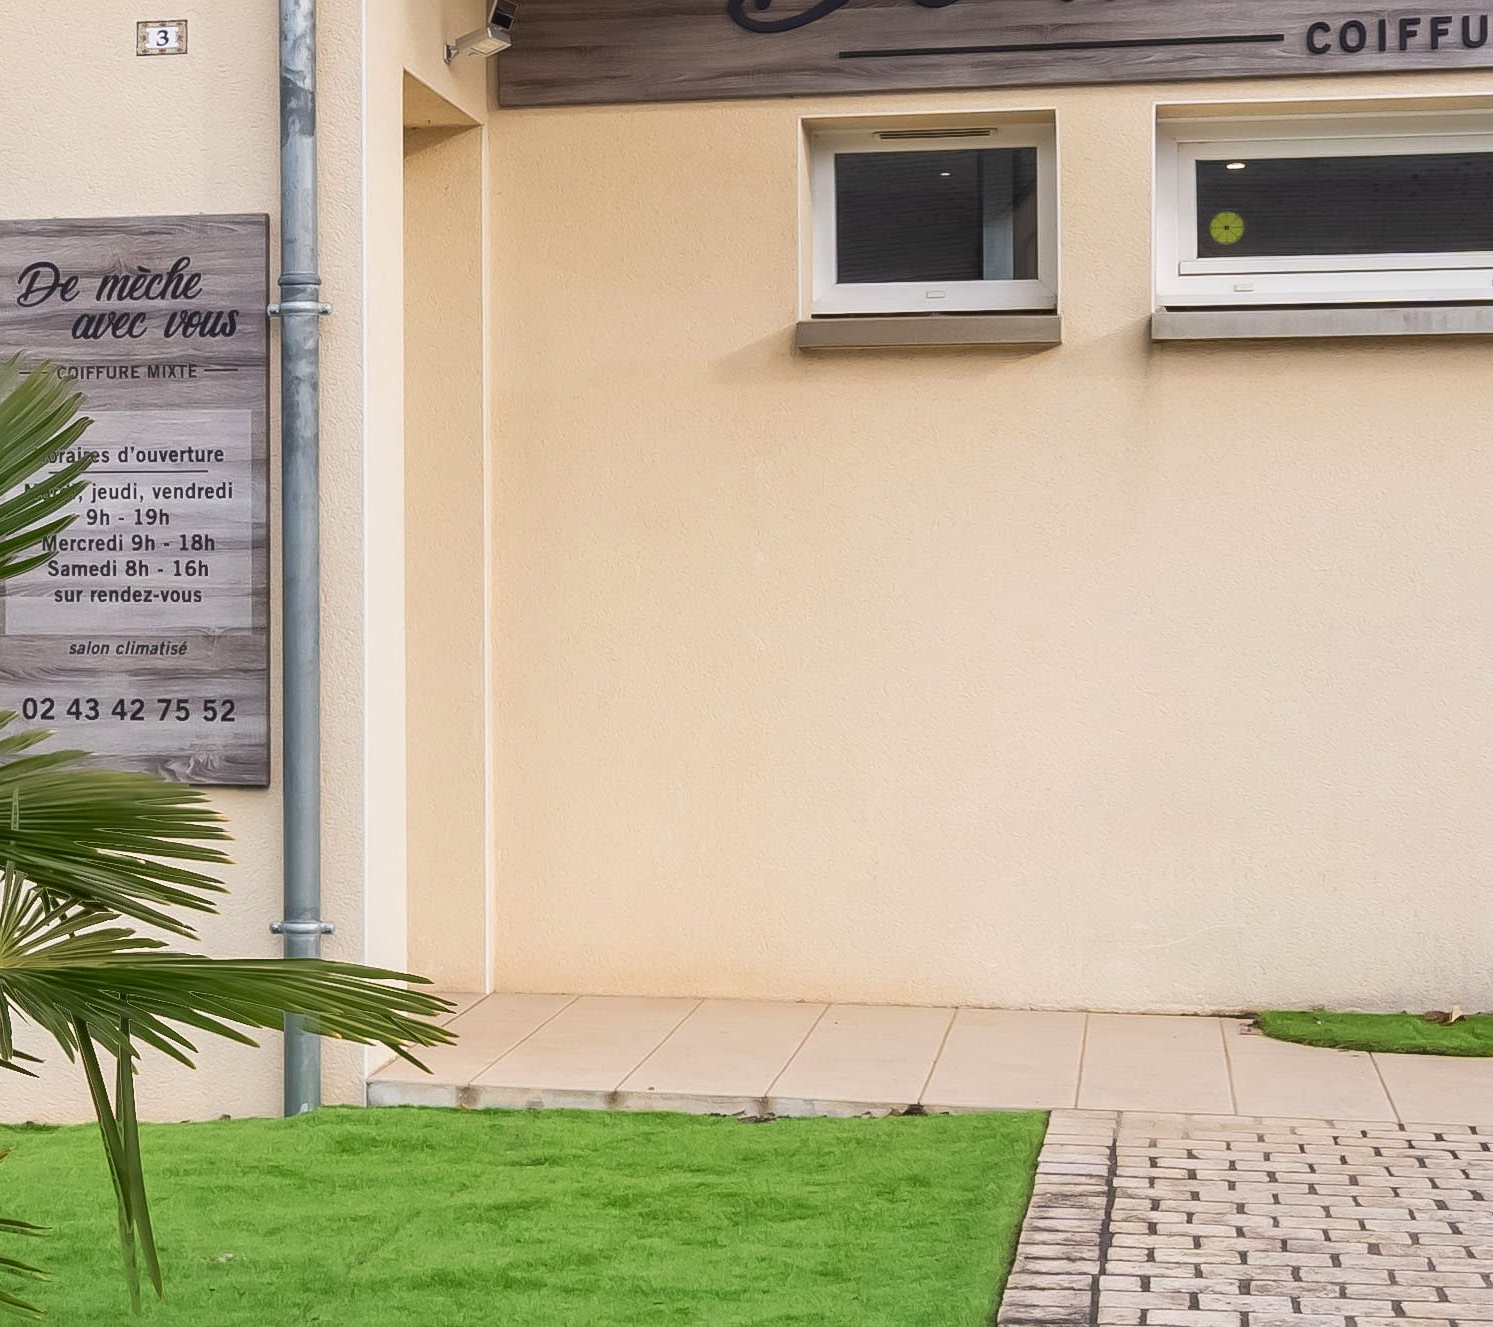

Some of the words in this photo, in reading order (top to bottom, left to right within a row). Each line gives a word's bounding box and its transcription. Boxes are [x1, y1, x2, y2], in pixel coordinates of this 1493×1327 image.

[156, 29, 169, 47] 3
[16, 261, 80, 308] De
[95, 256, 203, 302] mèche
[71, 310, 148, 340] avec
[163, 309, 240, 339] vous
[56, 364, 141, 380] COIFFURE
[147, 363, 198, 379] MIXTE
[42, 446, 110, 464] oraies
[90, 482, 144, 504] jeudi,
[152, 481, 234, 500] vendredi
[85, 508, 111, 526] 9h
[134, 508, 170, 526] 19h
[42, 533, 124, 552] Mercredi
[131, 533, 156, 552] 9h
[179, 533, 216, 552] 18h
[47, 559, 117, 577] Samedi
[124, 559, 149, 577] 8h
[173, 559, 209, 577] 16h
[54, 589, 83, 603] sur
[90, 586, 203, 603] rendez-vous
[69, 640, 110, 655] salon
[115, 640, 188, 656] climatisé
[22, 697, 56, 721] 02
[66, 697, 100, 721] 43
[111, 698, 145, 721] 42
[156, 698, 190, 722] 75
[202, 698, 236, 722] 52
